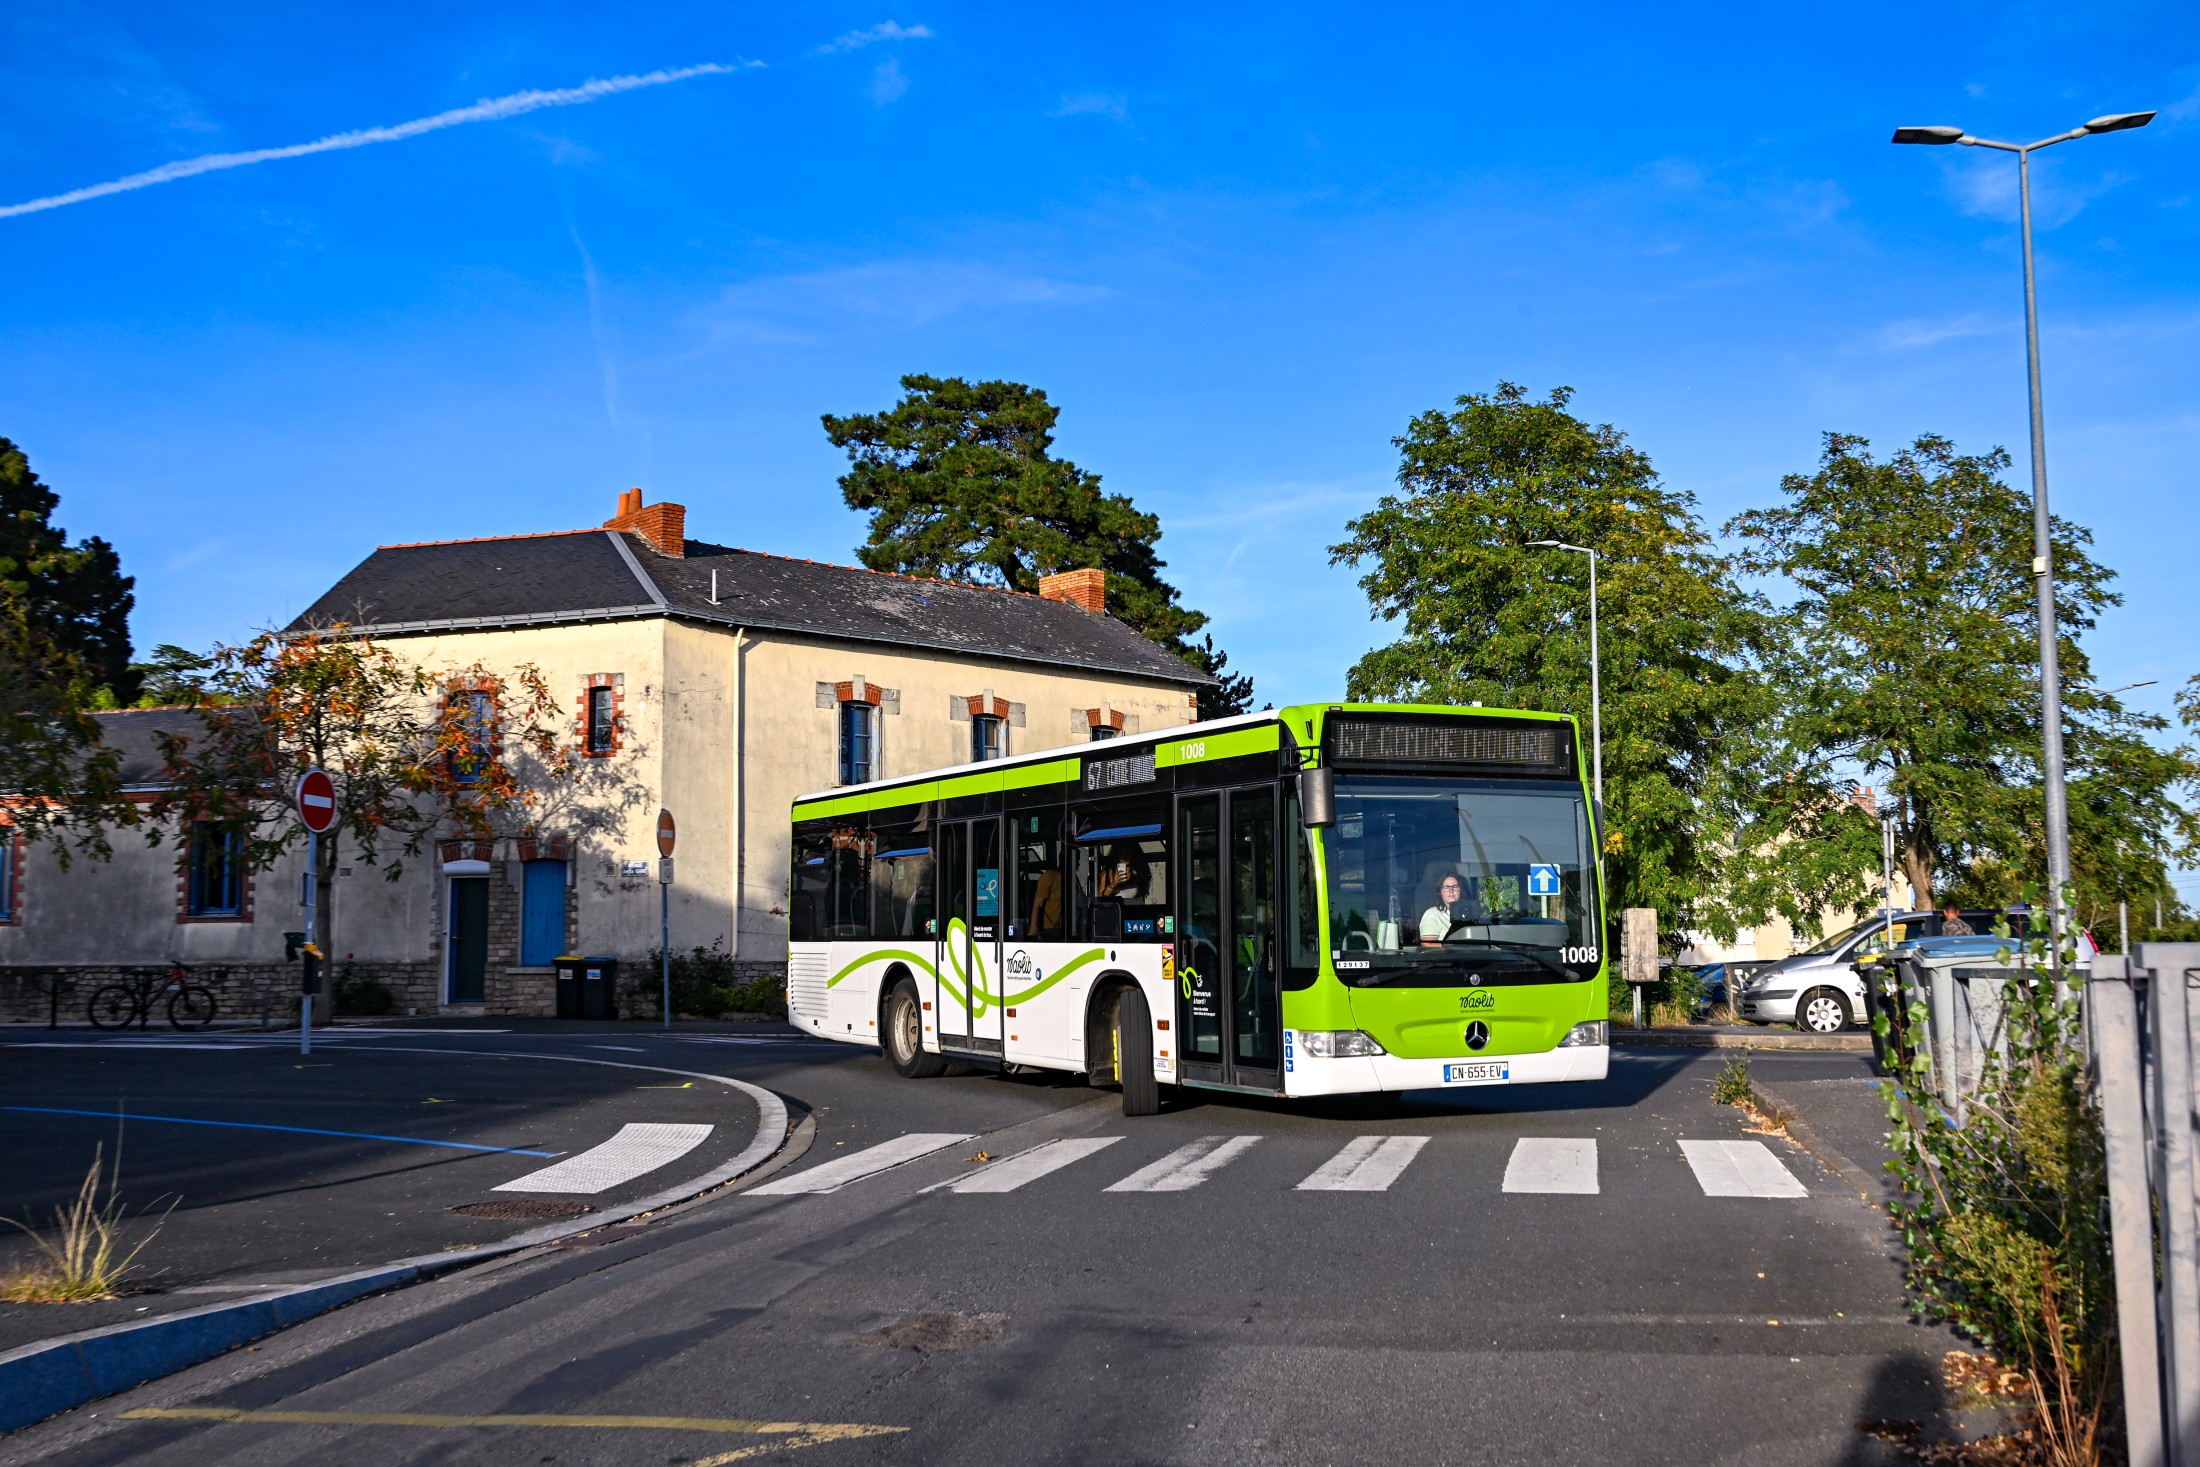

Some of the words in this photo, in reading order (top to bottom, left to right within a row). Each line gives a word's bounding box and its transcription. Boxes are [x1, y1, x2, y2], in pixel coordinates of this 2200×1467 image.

[1340, 723, 1369, 758] 67
[1379, 726, 1457, 758] CENTRE
[1180, 742, 1205, 760] 1008
[1087, 761, 1102, 790] 67
[1559, 946, 1598, 964] 1008
[1452, 1065, 1501, 1079] CN-655-EV
